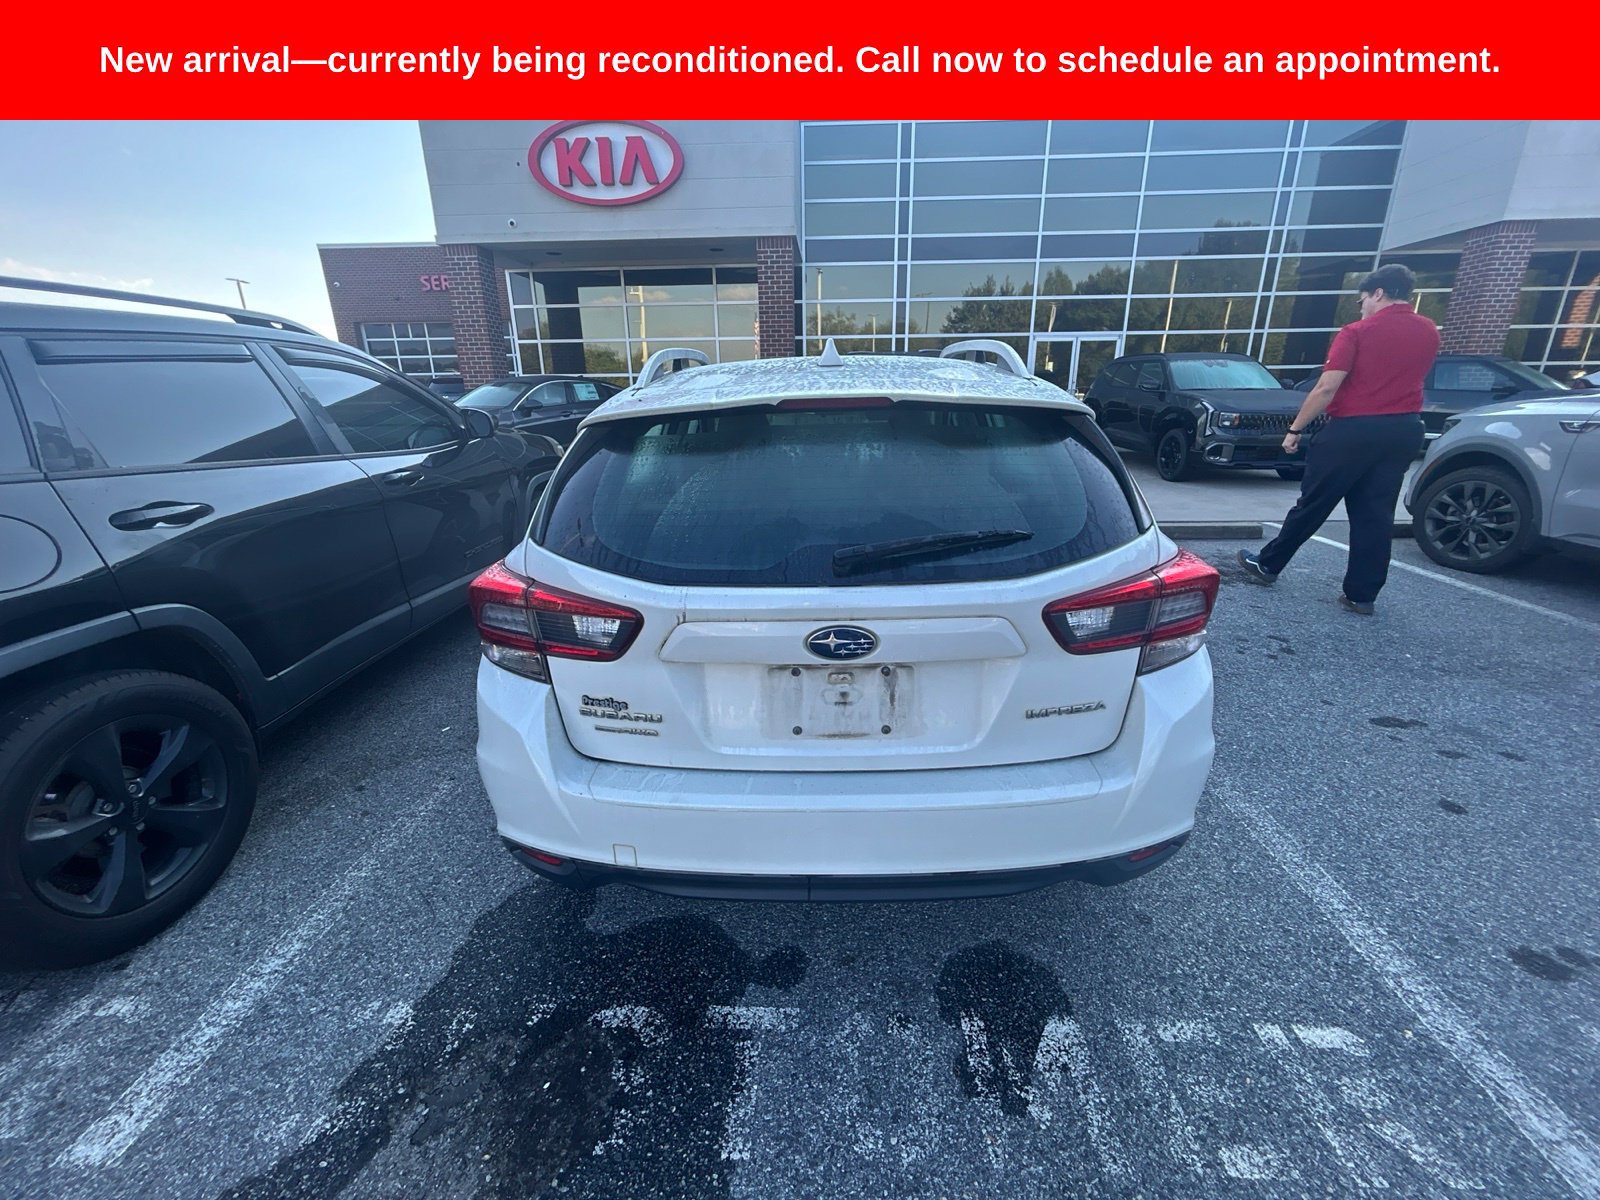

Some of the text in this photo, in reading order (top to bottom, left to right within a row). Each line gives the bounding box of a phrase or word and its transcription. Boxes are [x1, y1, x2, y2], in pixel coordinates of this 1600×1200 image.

[552, 136, 660, 187] KIA
[581, 694, 629, 711] Prestige
[1025, 701, 1106, 719] IMPREZA
[579, 707, 663, 724] SUBARU
